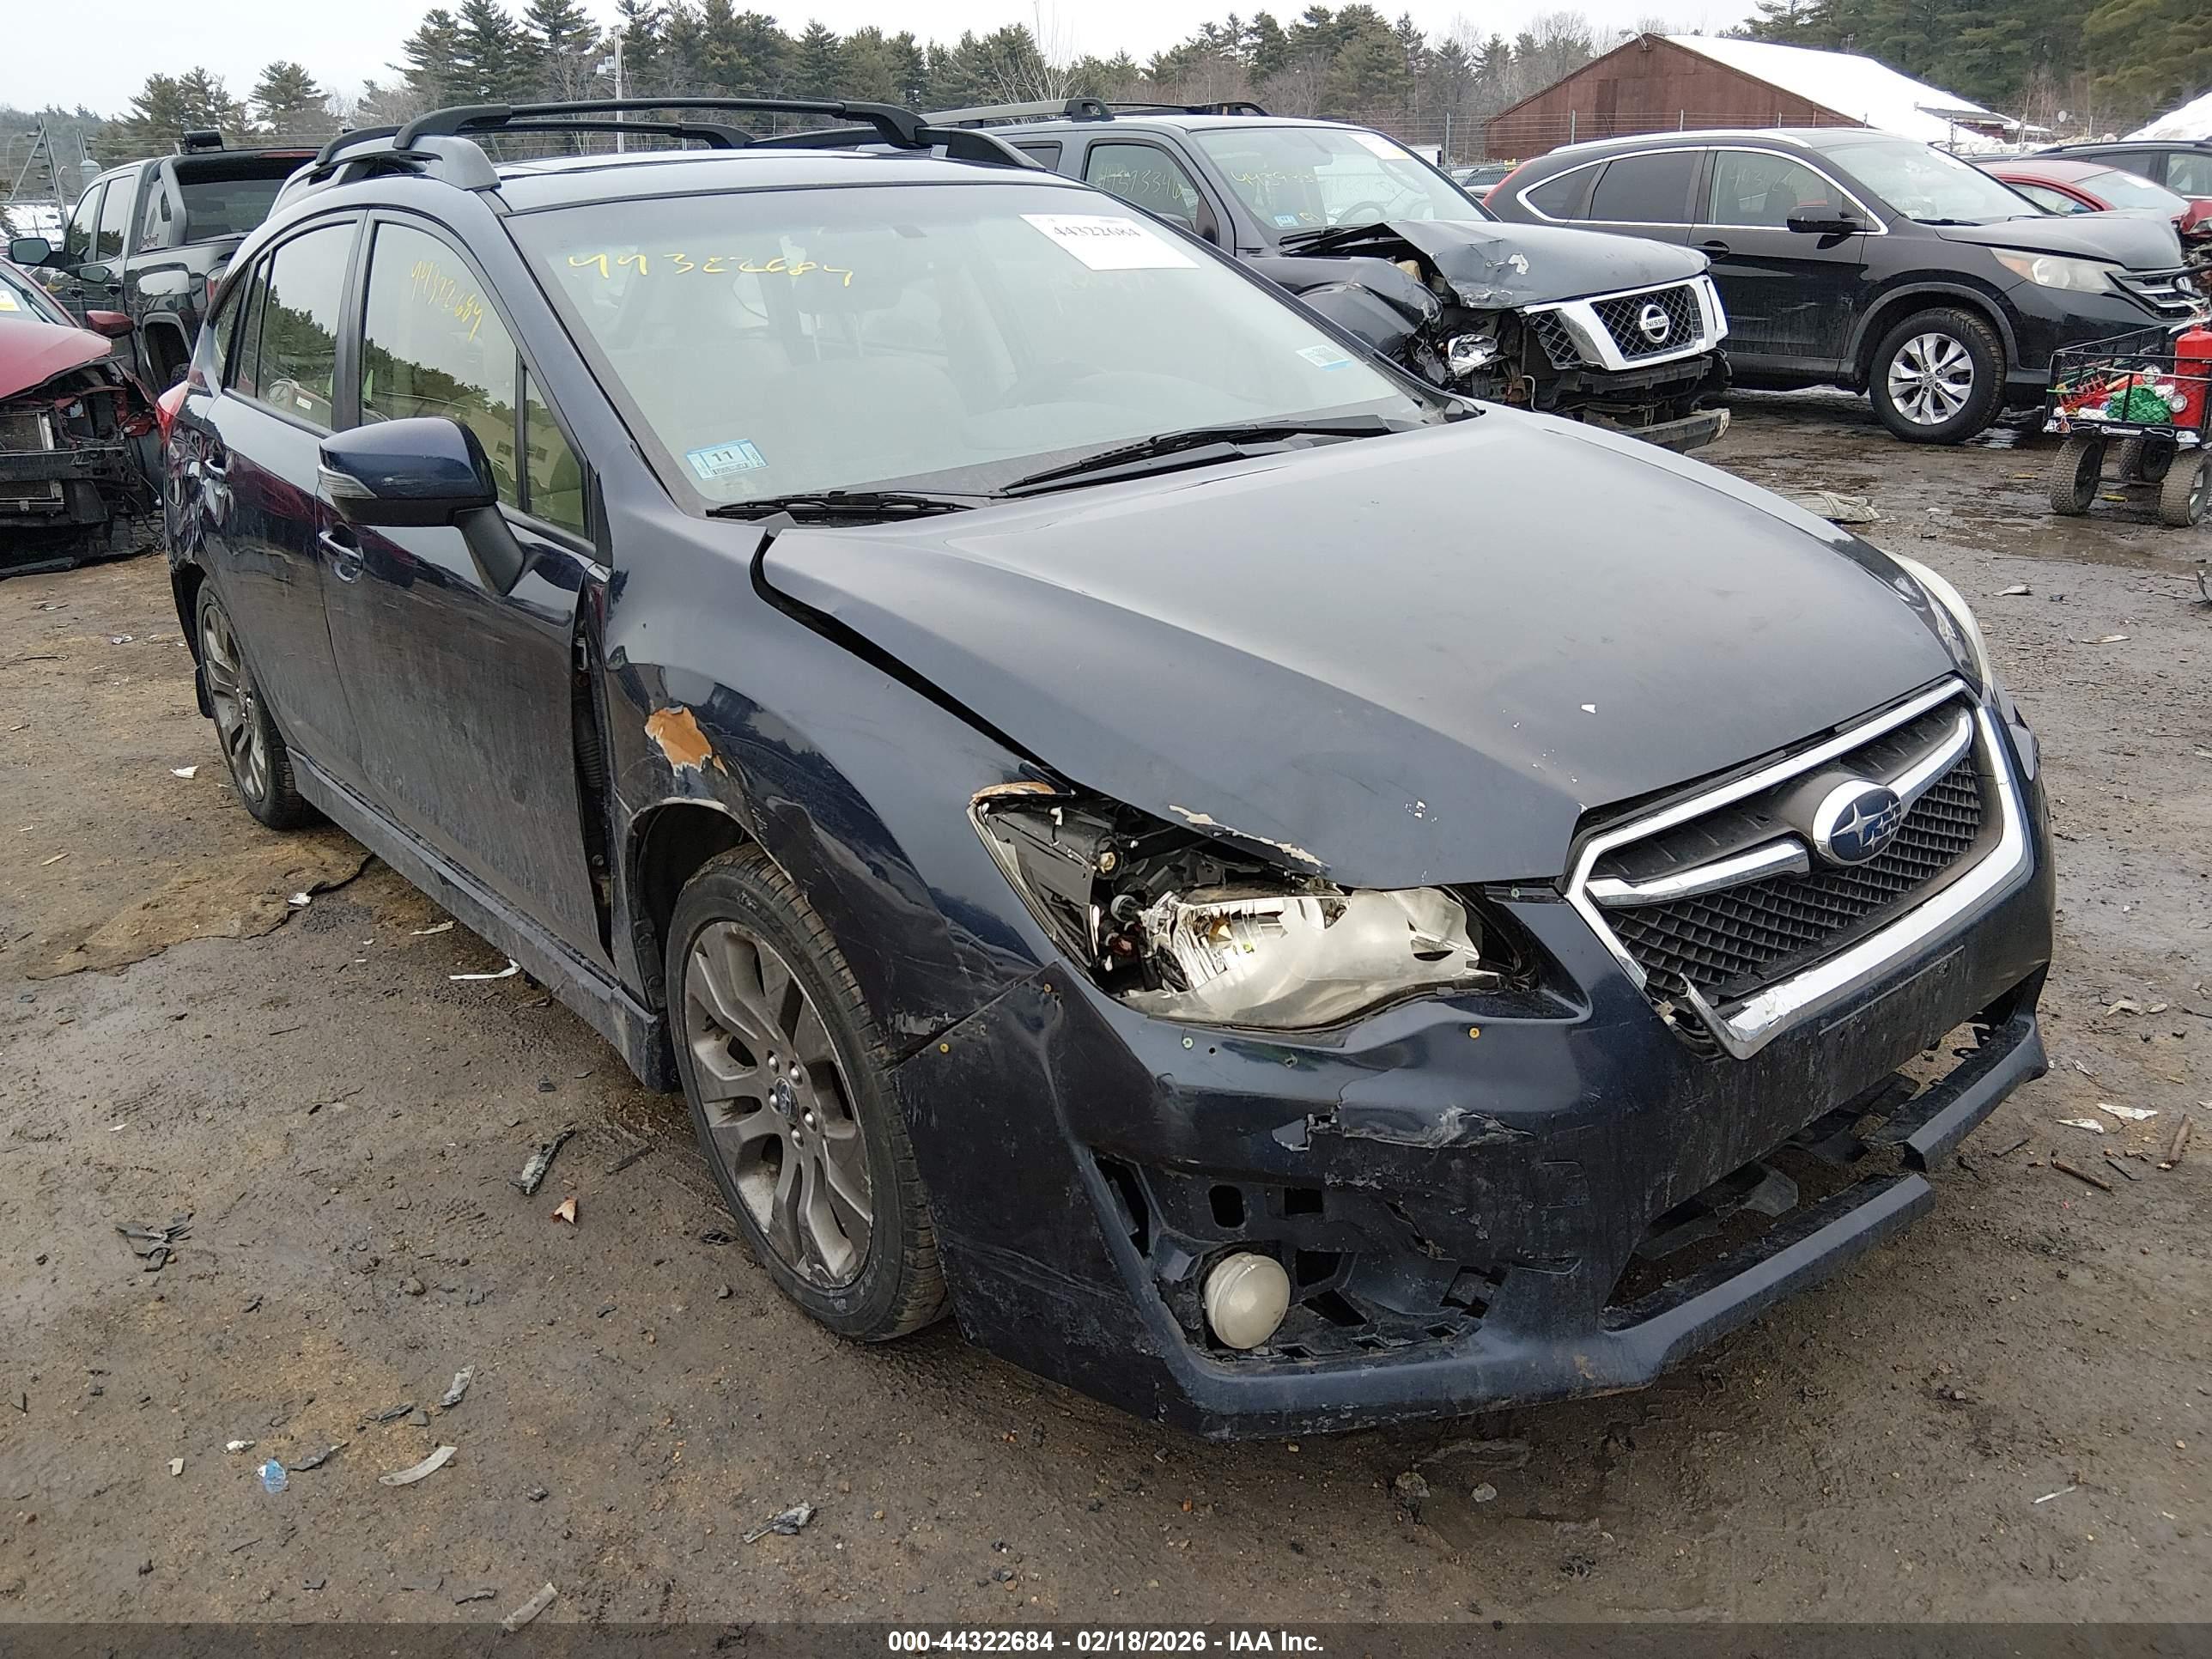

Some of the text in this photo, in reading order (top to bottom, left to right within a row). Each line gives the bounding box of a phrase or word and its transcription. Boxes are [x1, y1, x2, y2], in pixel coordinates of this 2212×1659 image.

[1053, 225, 1141, 237] 44322684
[568, 252, 854, 287] 44322684
[411, 260, 483, 343] 44322684
[711, 450, 734, 462] 11
